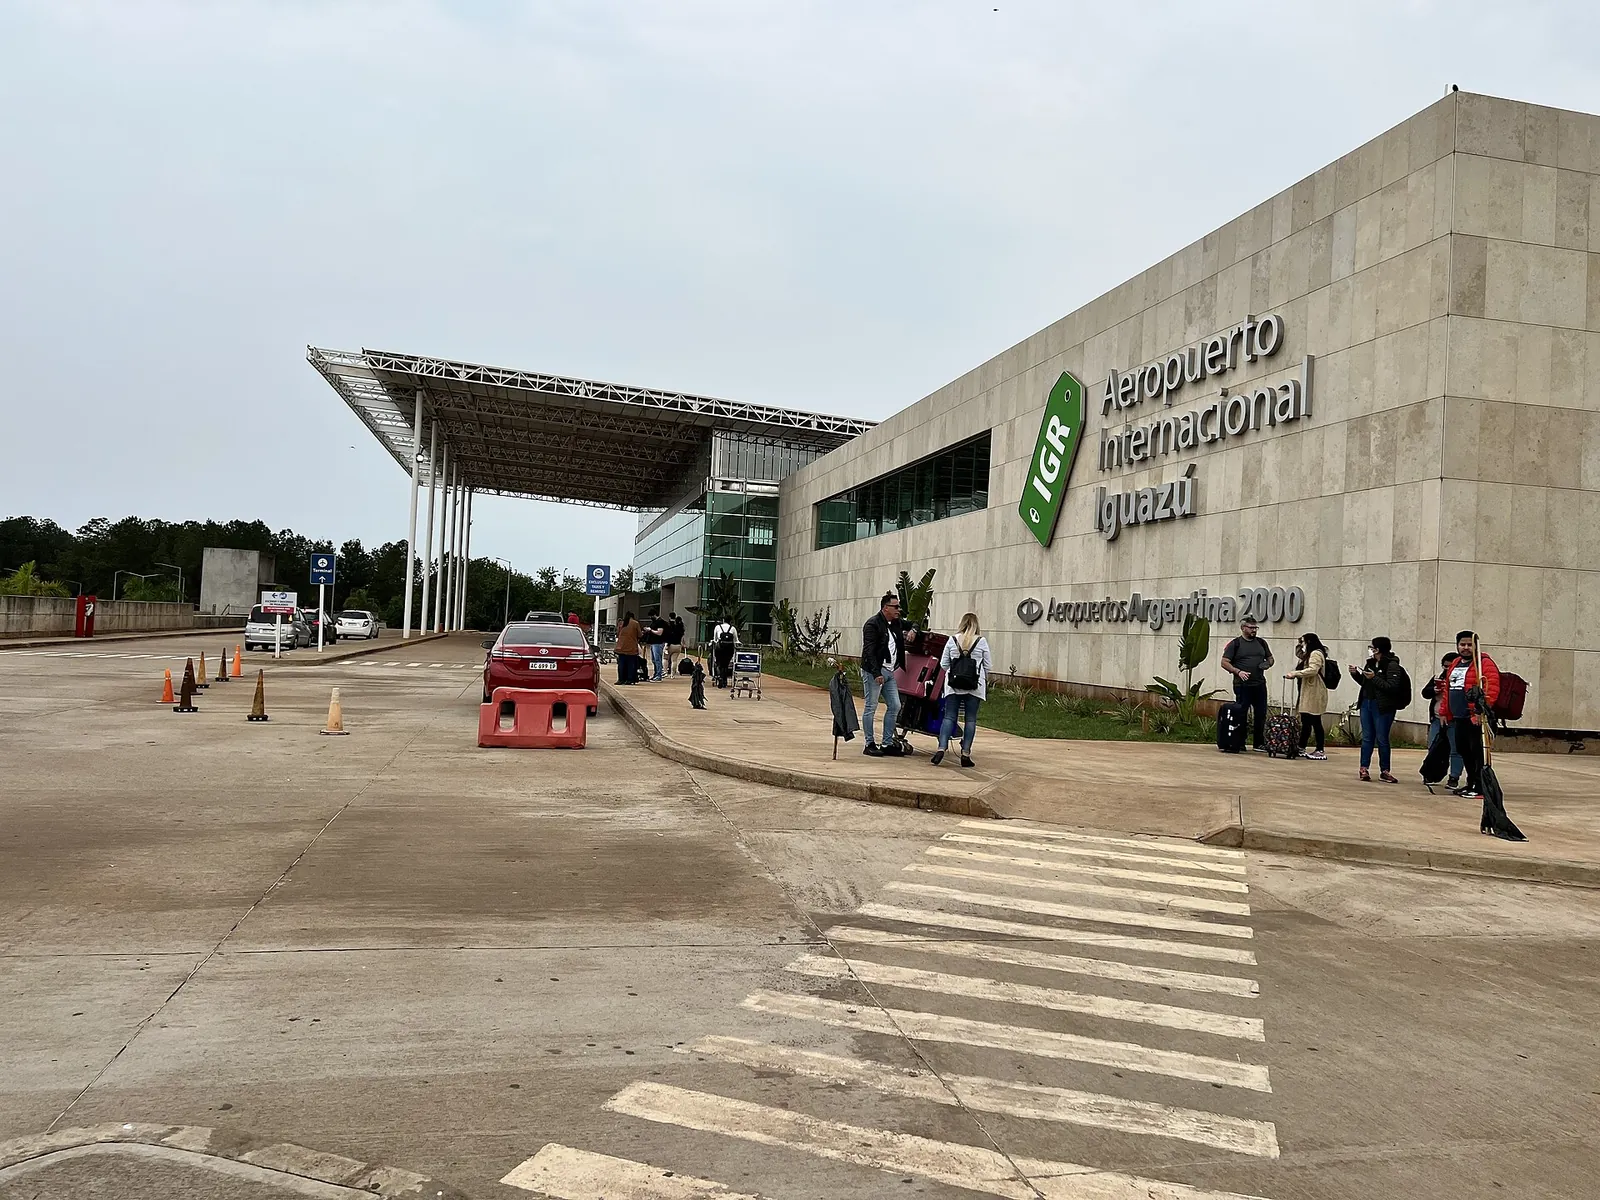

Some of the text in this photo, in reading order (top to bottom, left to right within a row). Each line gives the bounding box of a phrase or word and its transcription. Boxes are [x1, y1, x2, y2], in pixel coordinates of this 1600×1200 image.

[1100, 314, 1285, 416] Aeropuerto
[1097, 354, 1315, 471] Internacional
[1032, 414, 1071, 504] IGR
[1094, 463, 1198, 541] Iguazú
[1238, 585, 1304, 623] 2000
